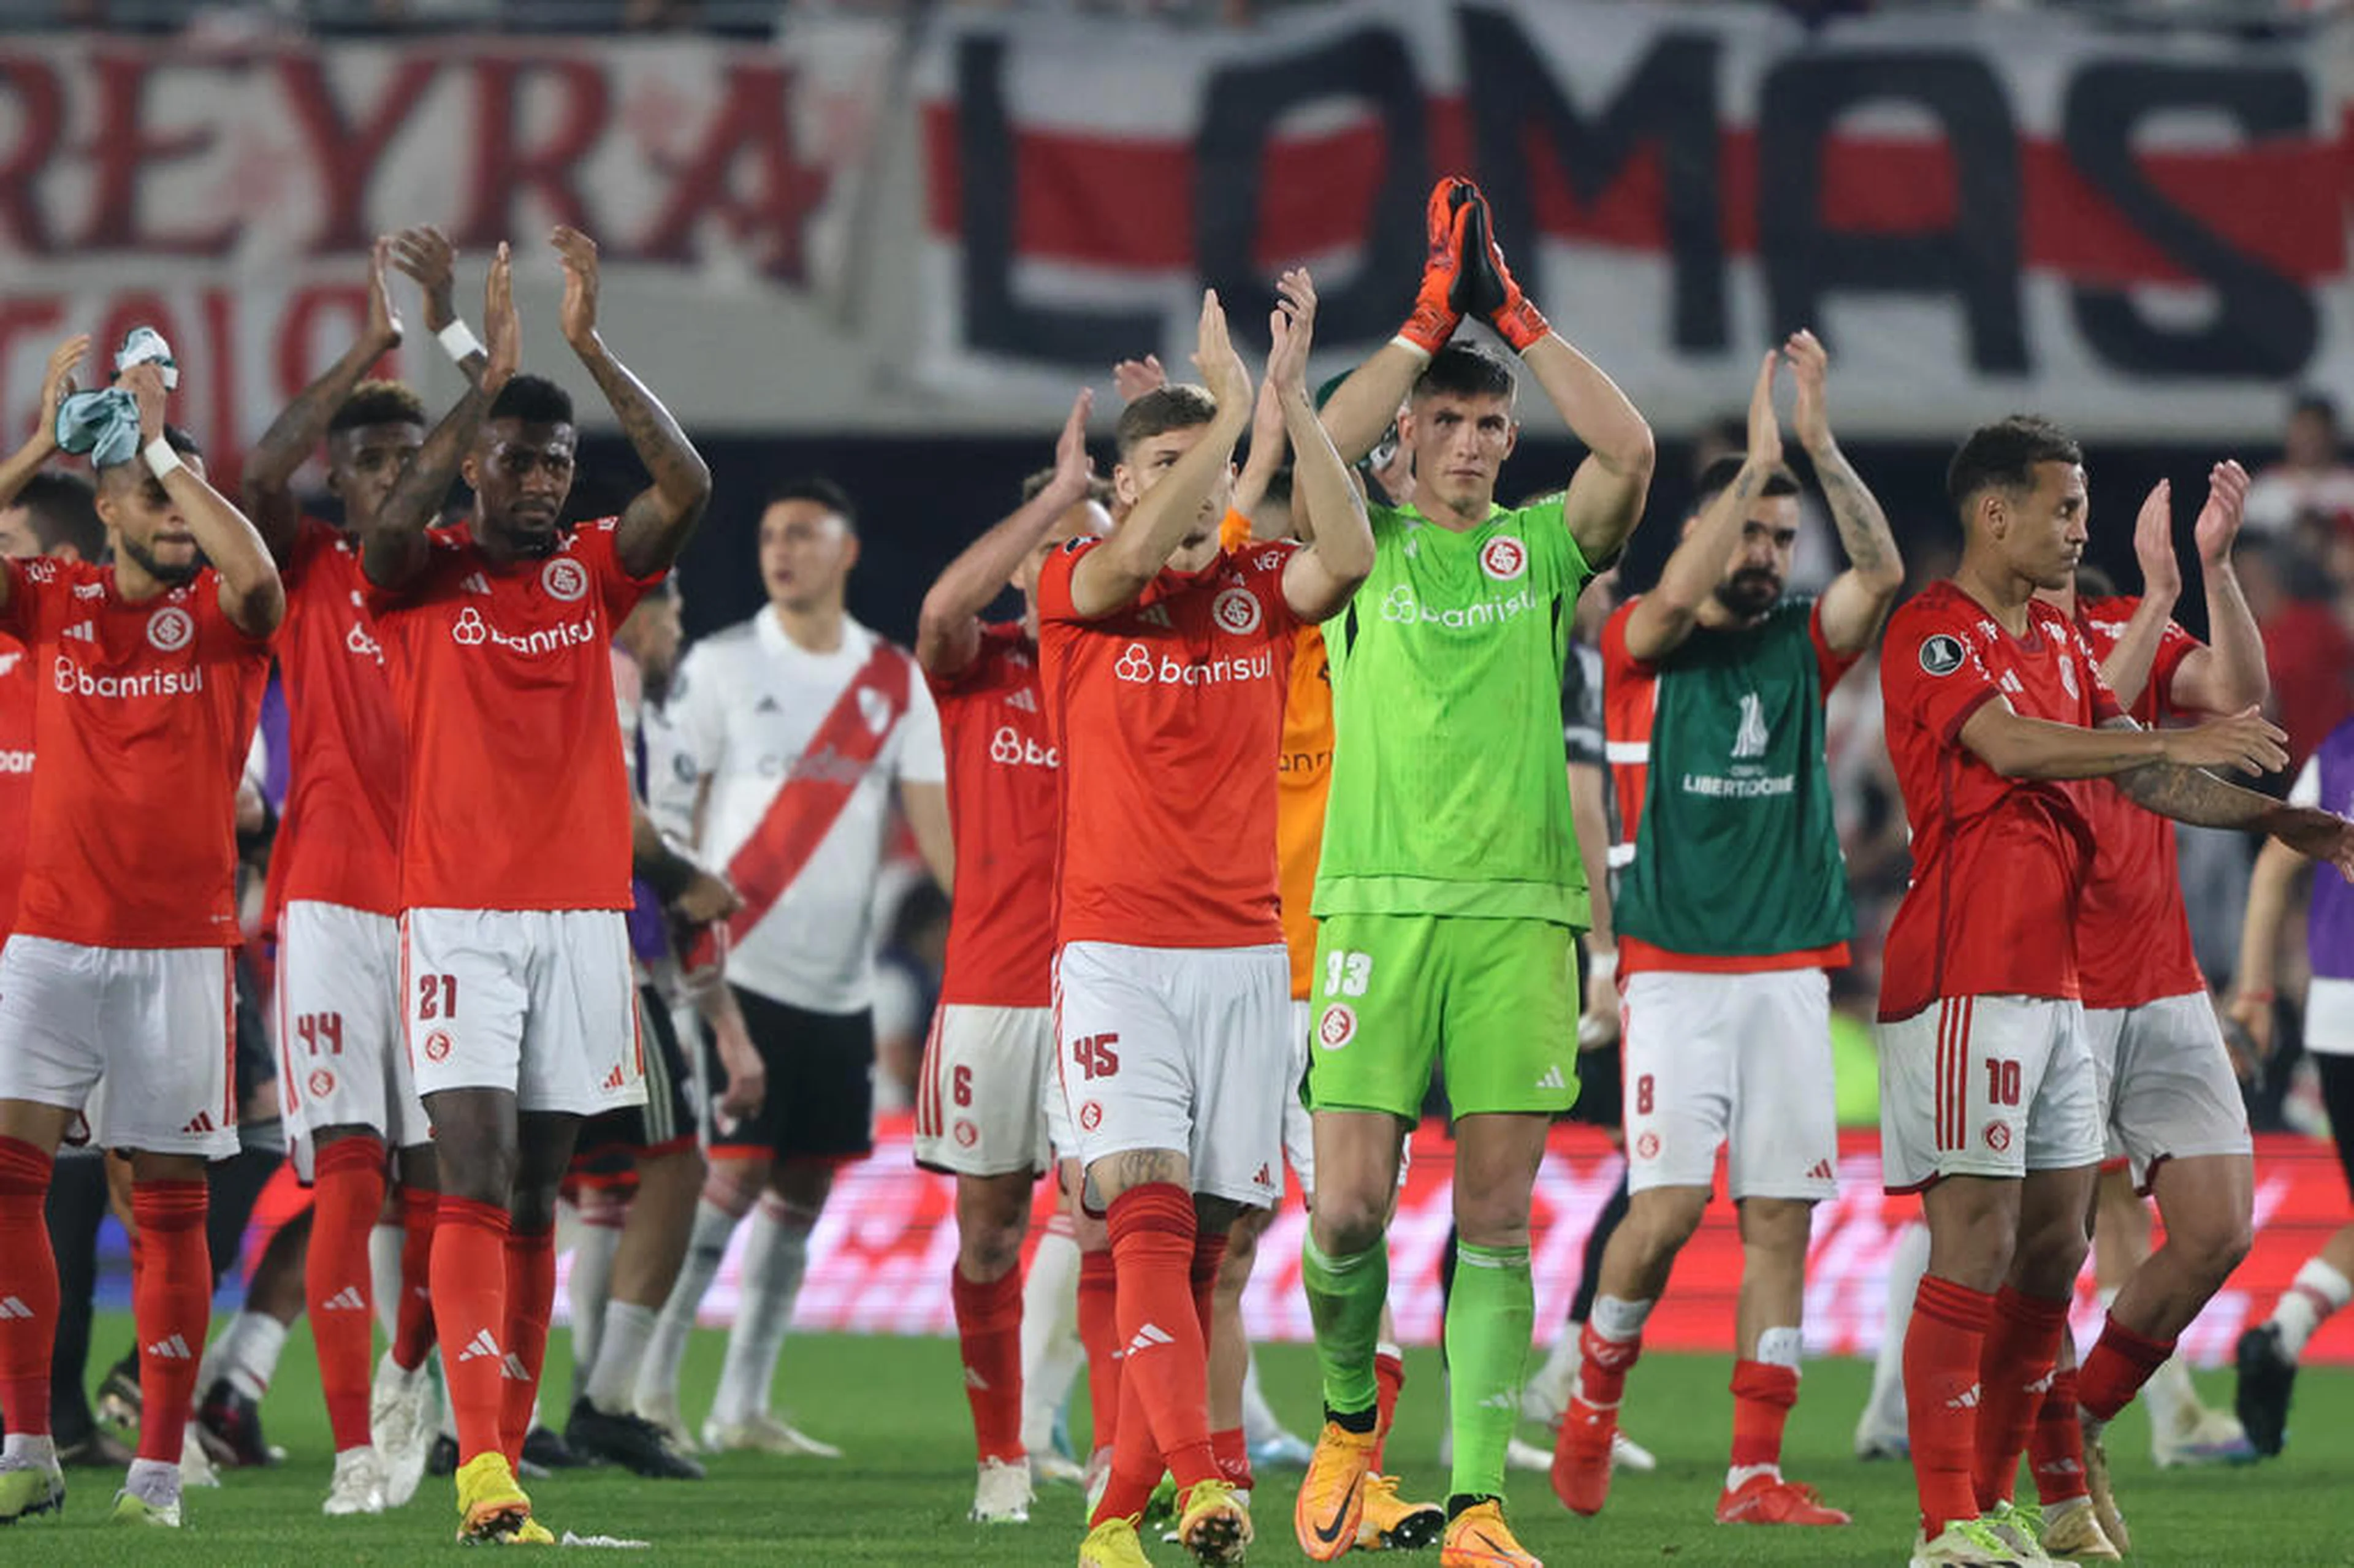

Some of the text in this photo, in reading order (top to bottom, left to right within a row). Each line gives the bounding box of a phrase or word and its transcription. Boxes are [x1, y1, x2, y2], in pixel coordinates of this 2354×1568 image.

[954, 3, 2320, 386] LOMAS
[78, 664, 203, 698] banrisul
[419, 974, 456, 1021] 21
[297, 1011, 342, 1056] 44
[1073, 1033, 1118, 1081] 45
[953, 1064, 972, 1108] 6
[1637, 1073, 1655, 1116] 8
[1986, 1057, 2021, 1106] 10
